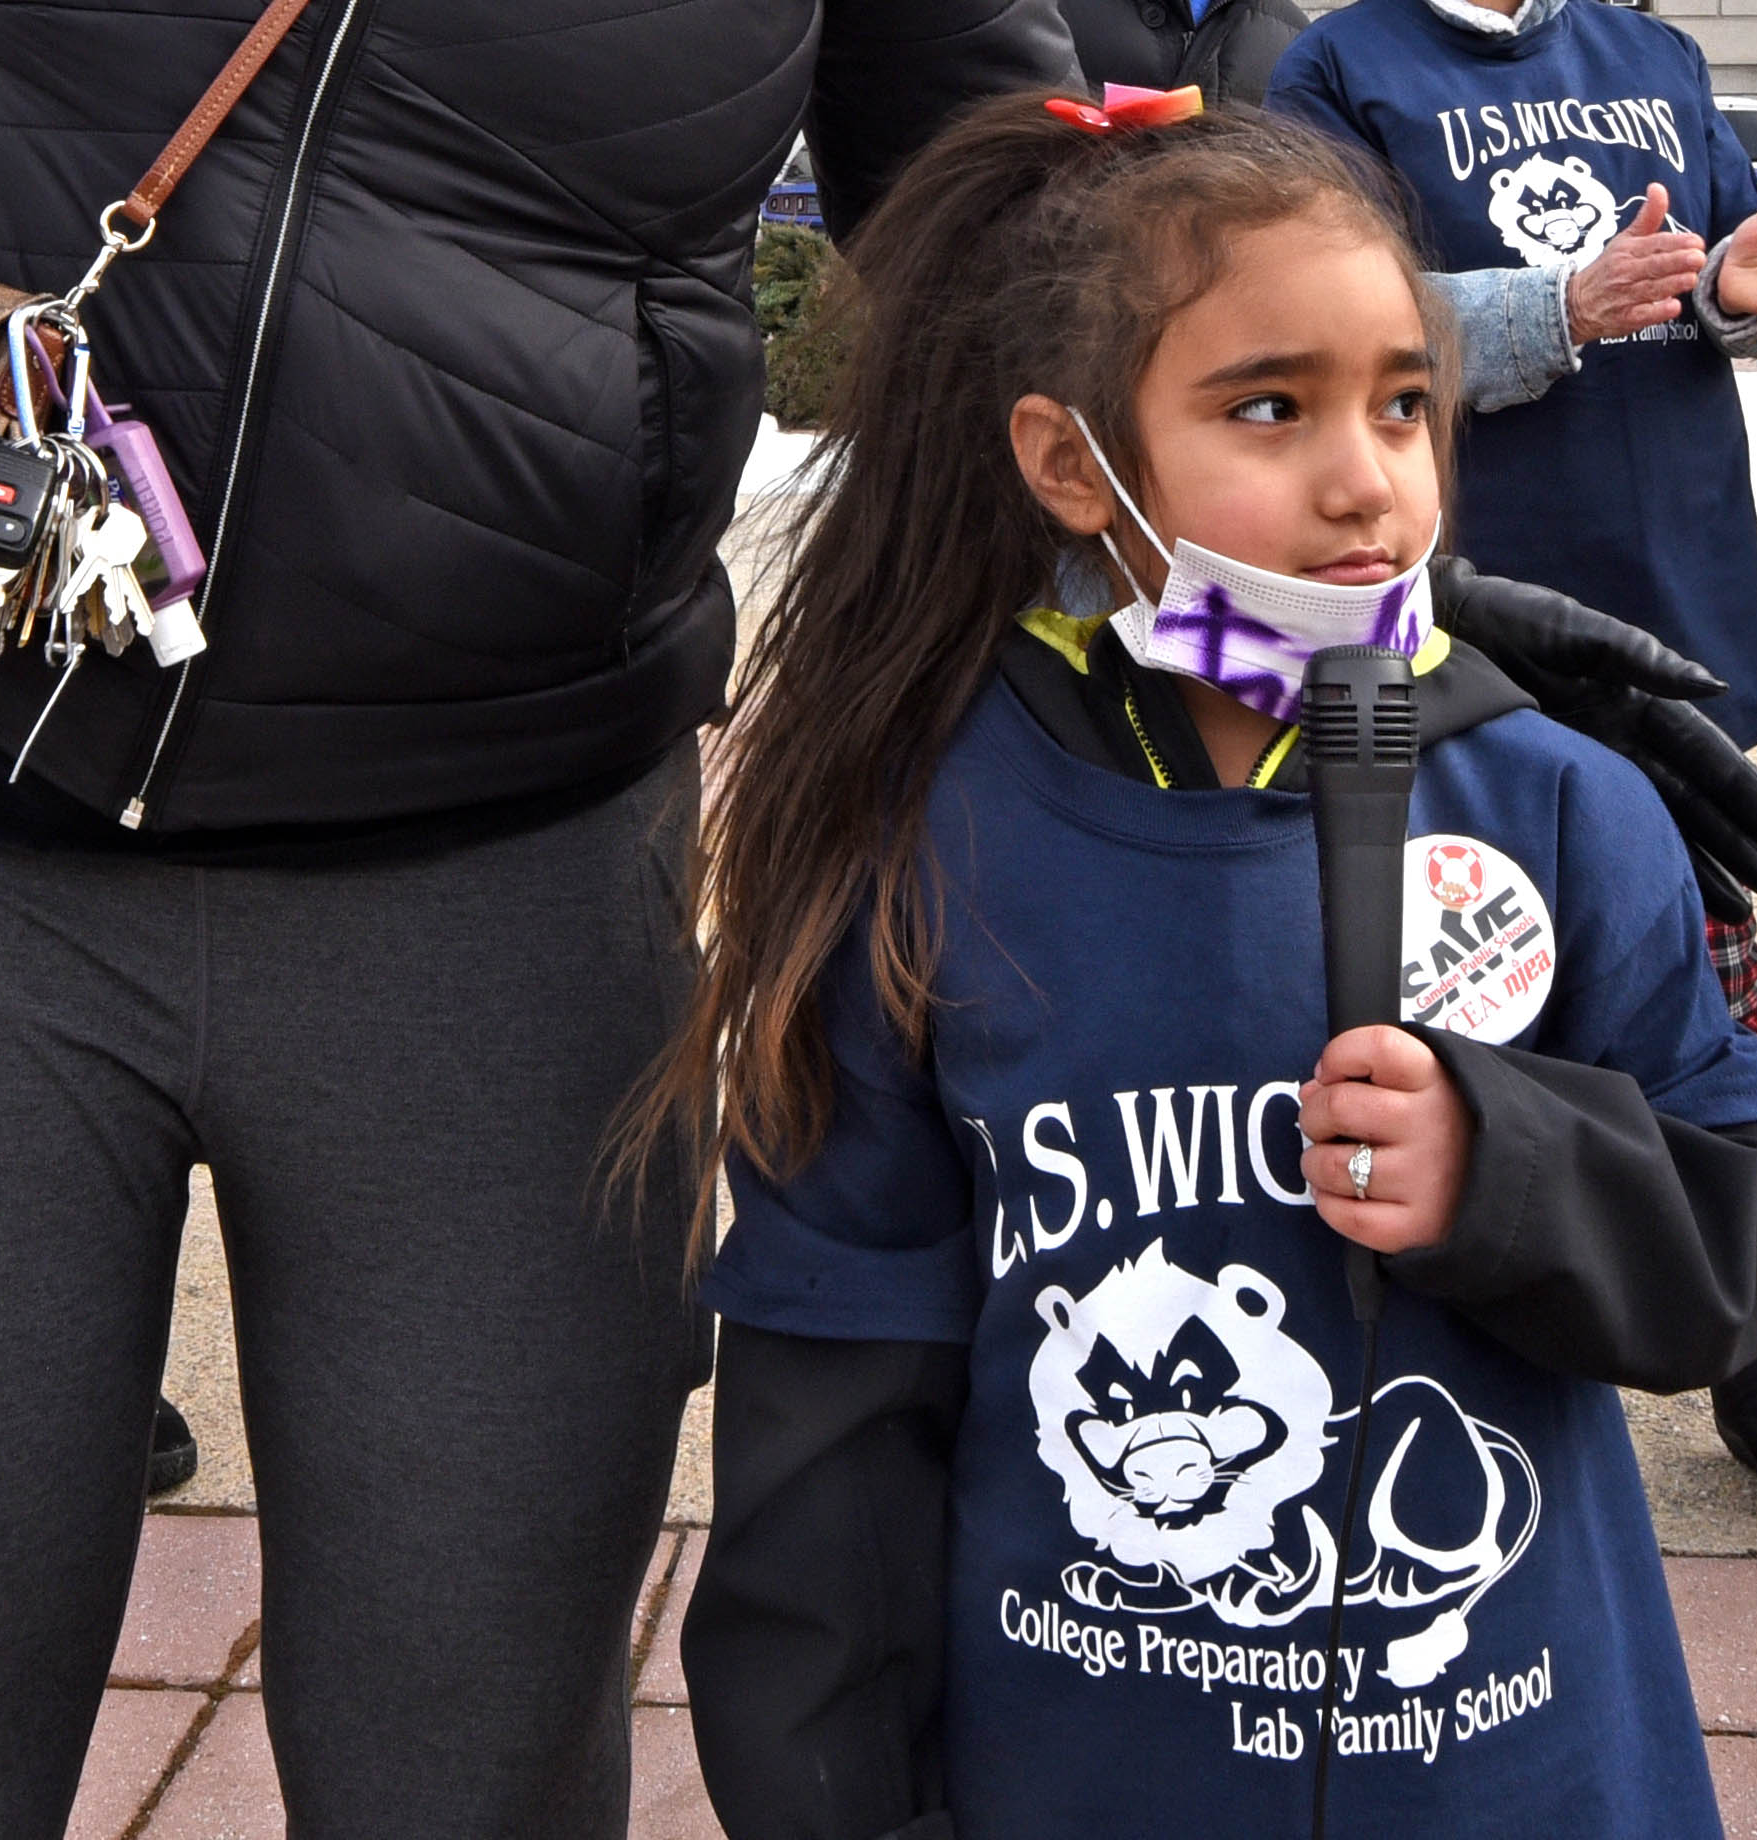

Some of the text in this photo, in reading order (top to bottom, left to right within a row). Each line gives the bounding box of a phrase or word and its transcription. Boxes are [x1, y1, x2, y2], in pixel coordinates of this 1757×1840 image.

[1415, 913, 1536, 1010] Camden Public Schools
[1502, 948, 1553, 998] njea
[1444, 991, 1501, 1032] CEA
[1000, 1588, 1127, 1678] College
[1230, 1701, 1305, 1761] Lab
[1454, 1647, 1554, 1742] School
